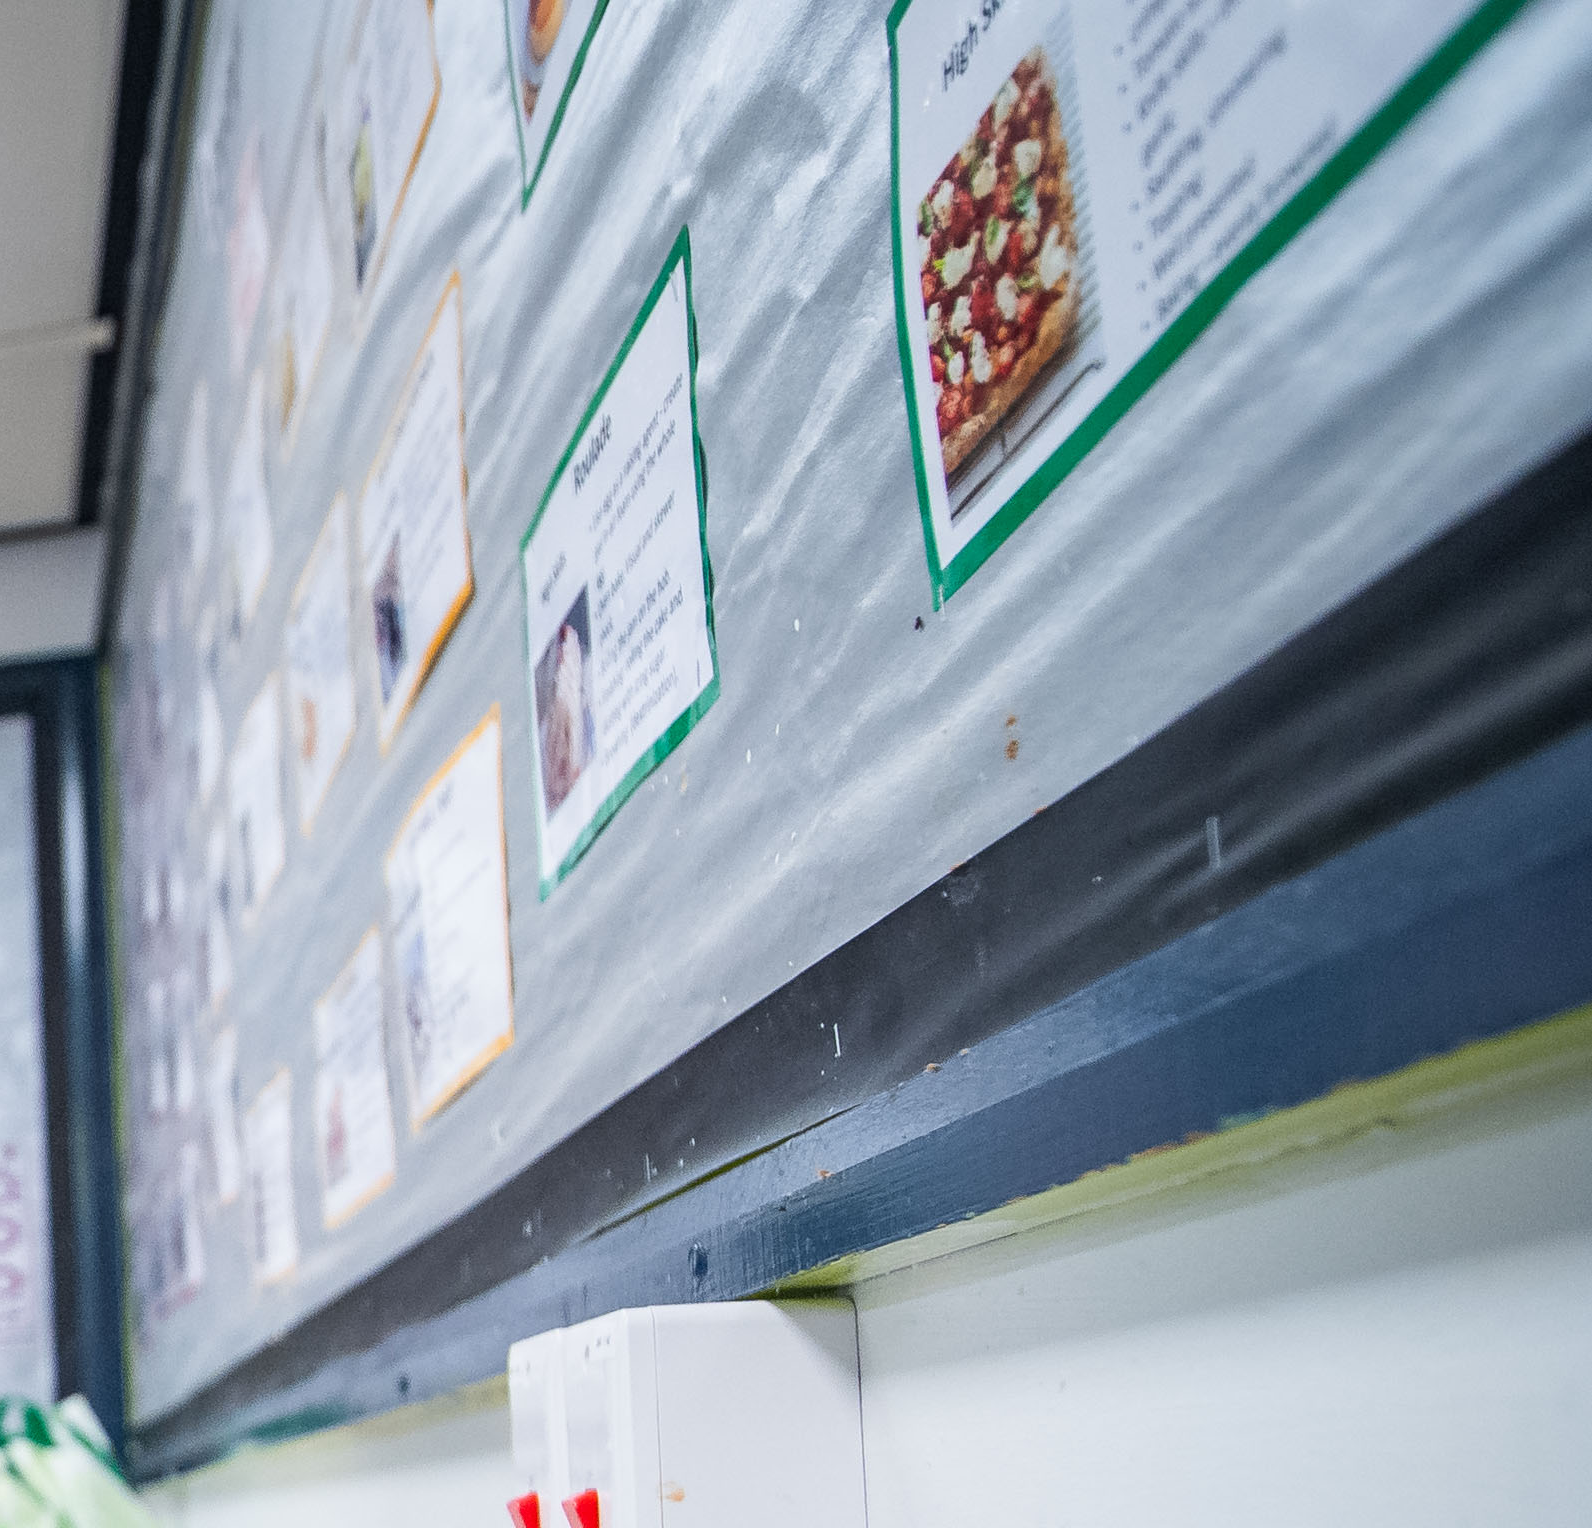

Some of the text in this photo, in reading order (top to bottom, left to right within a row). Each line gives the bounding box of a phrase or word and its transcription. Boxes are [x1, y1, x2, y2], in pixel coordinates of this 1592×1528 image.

[942, 20, 978, 92] High
[573, 413, 612, 495] Roulade
[654, 606, 668, 634] cake
[669, 586, 683, 615] and
